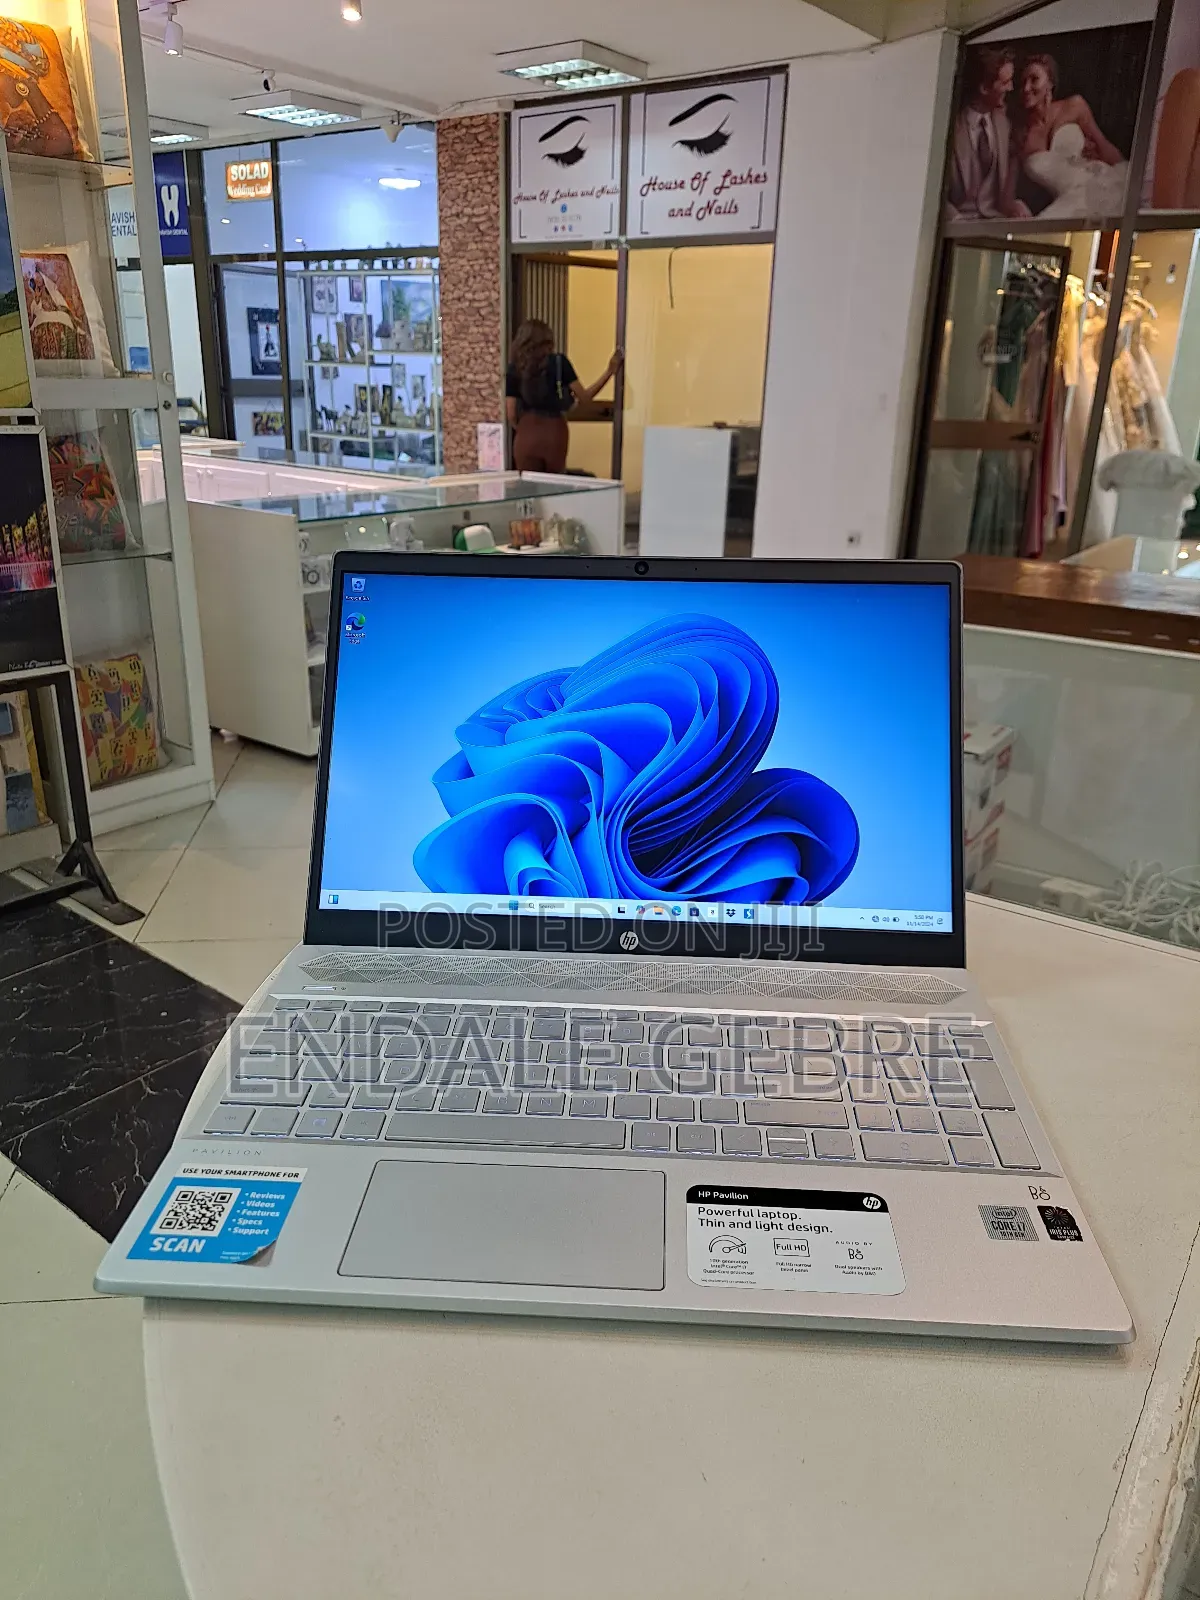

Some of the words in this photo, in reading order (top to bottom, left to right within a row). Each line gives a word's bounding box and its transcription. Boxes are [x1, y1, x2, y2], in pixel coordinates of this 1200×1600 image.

[231, 161, 269, 181] SOLAD
[640, 176, 685, 197] House
[690, 171, 711, 196] Of
[713, 167, 768, 195] Lashes
[668, 201, 695, 218] and
[696, 197, 739, 221] Nails
[111, 211, 136, 225] AVISH
[112, 225, 137, 237] ENTAL
[192, 1147, 262, 1156] PAVILION
[201, 1168, 223, 1176] YOUR
[225, 1169, 281, 1178] SMARTPHONE
[250, 1191, 286, 1201] Reviews
[698, 1190, 711, 1199] HP
[713, 1191, 749, 1200] Pavilion
[246, 1200, 275, 1209] Videos
[864, 1196, 881, 1210] hp
[241, 1209, 280, 1218] Features
[698, 1206, 754, 1218] Powerful
[757, 1208, 802, 1221] laptop.
[237, 1217, 263, 1227] Specs
[698, 1217, 725, 1229] Thin
[728, 1220, 751, 1230] and
[755, 1220, 784, 1232] light
[789, 1222, 833, 1235] design.
[991, 1220, 1016, 1232] CORE
[233, 1226, 269, 1236] Support
[149, 1236, 206, 1253] SCAN
[776, 1243, 792, 1252] Full
[794, 1244, 807, 1252] HD
